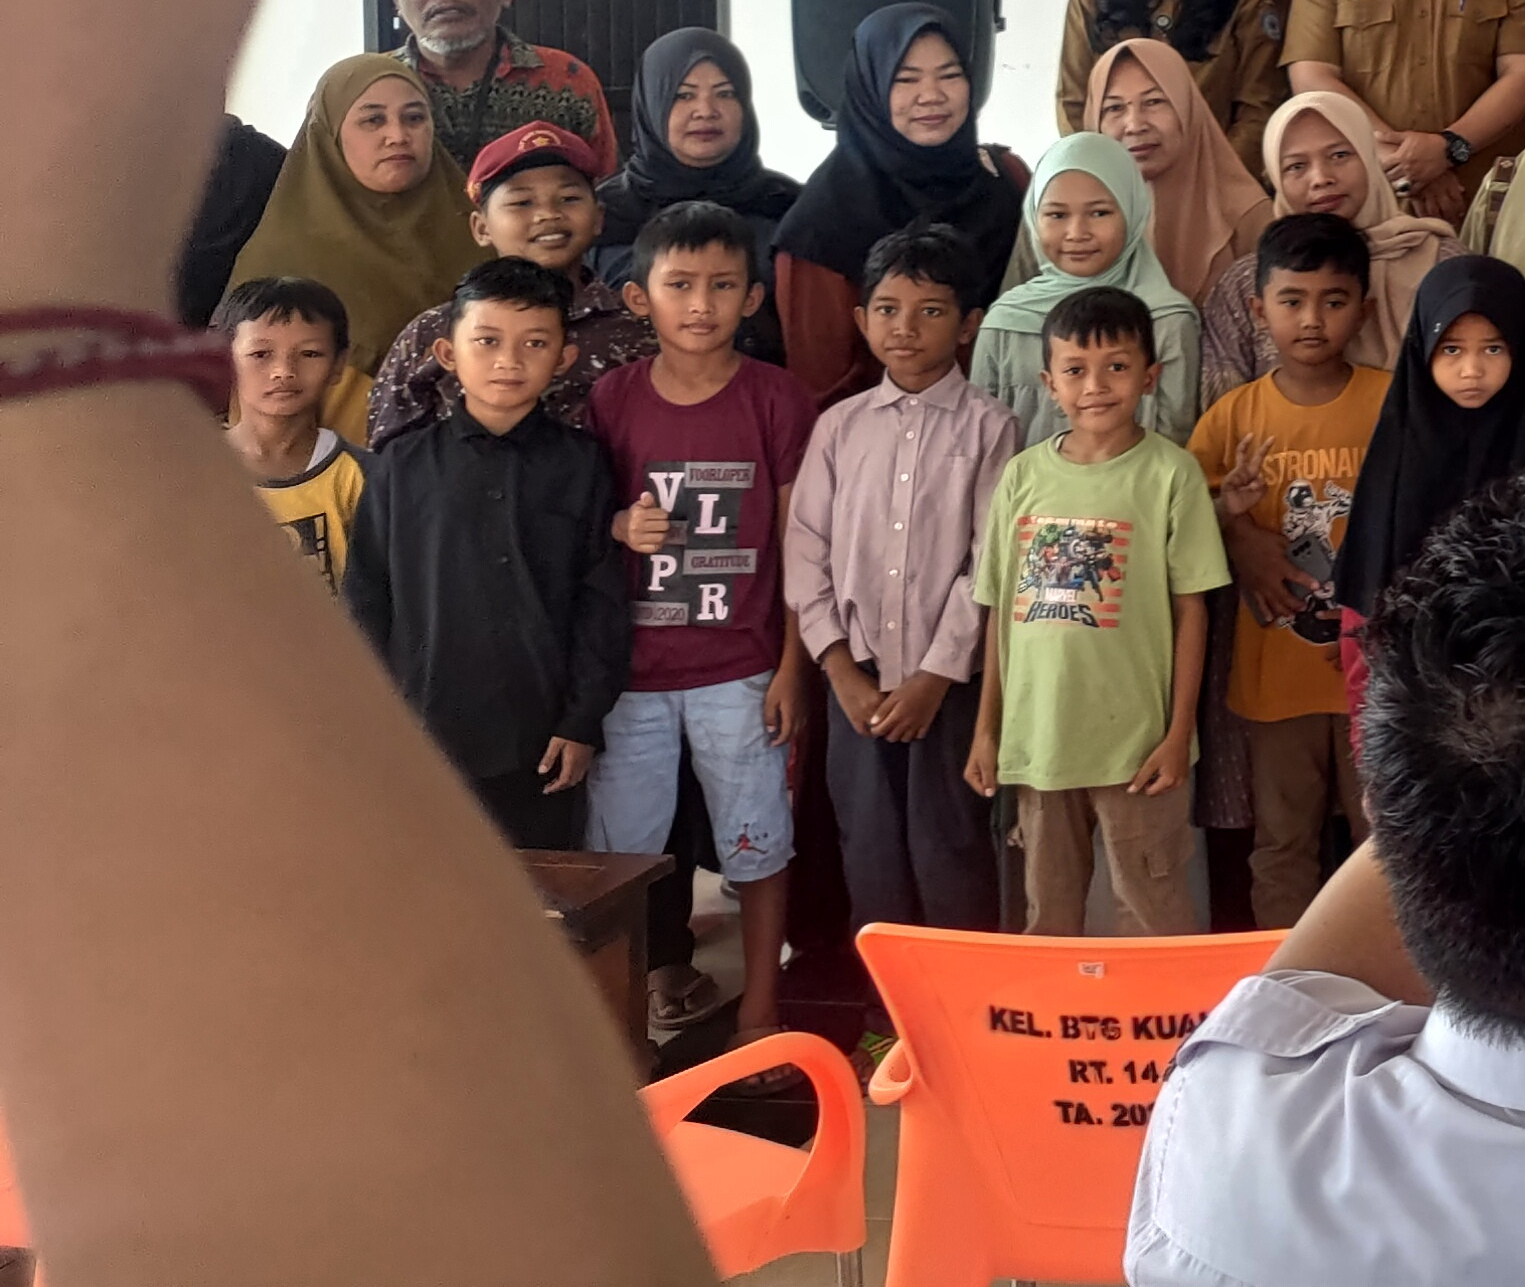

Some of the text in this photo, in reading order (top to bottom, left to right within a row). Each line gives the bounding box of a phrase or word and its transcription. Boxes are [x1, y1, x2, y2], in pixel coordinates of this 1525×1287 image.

[648, 471, 685, 513] V
[694, 493, 727, 534] L
[648, 554, 677, 592] P
[696, 582, 729, 621] R
[1023, 600, 1100, 628] HEROES
[989, 1005, 1052, 1038] KEL.
[1060, 1015, 1122, 1040] BTG
[1069, 1060, 1114, 1084] RT.
[1053, 1100, 1103, 1125] TA.
